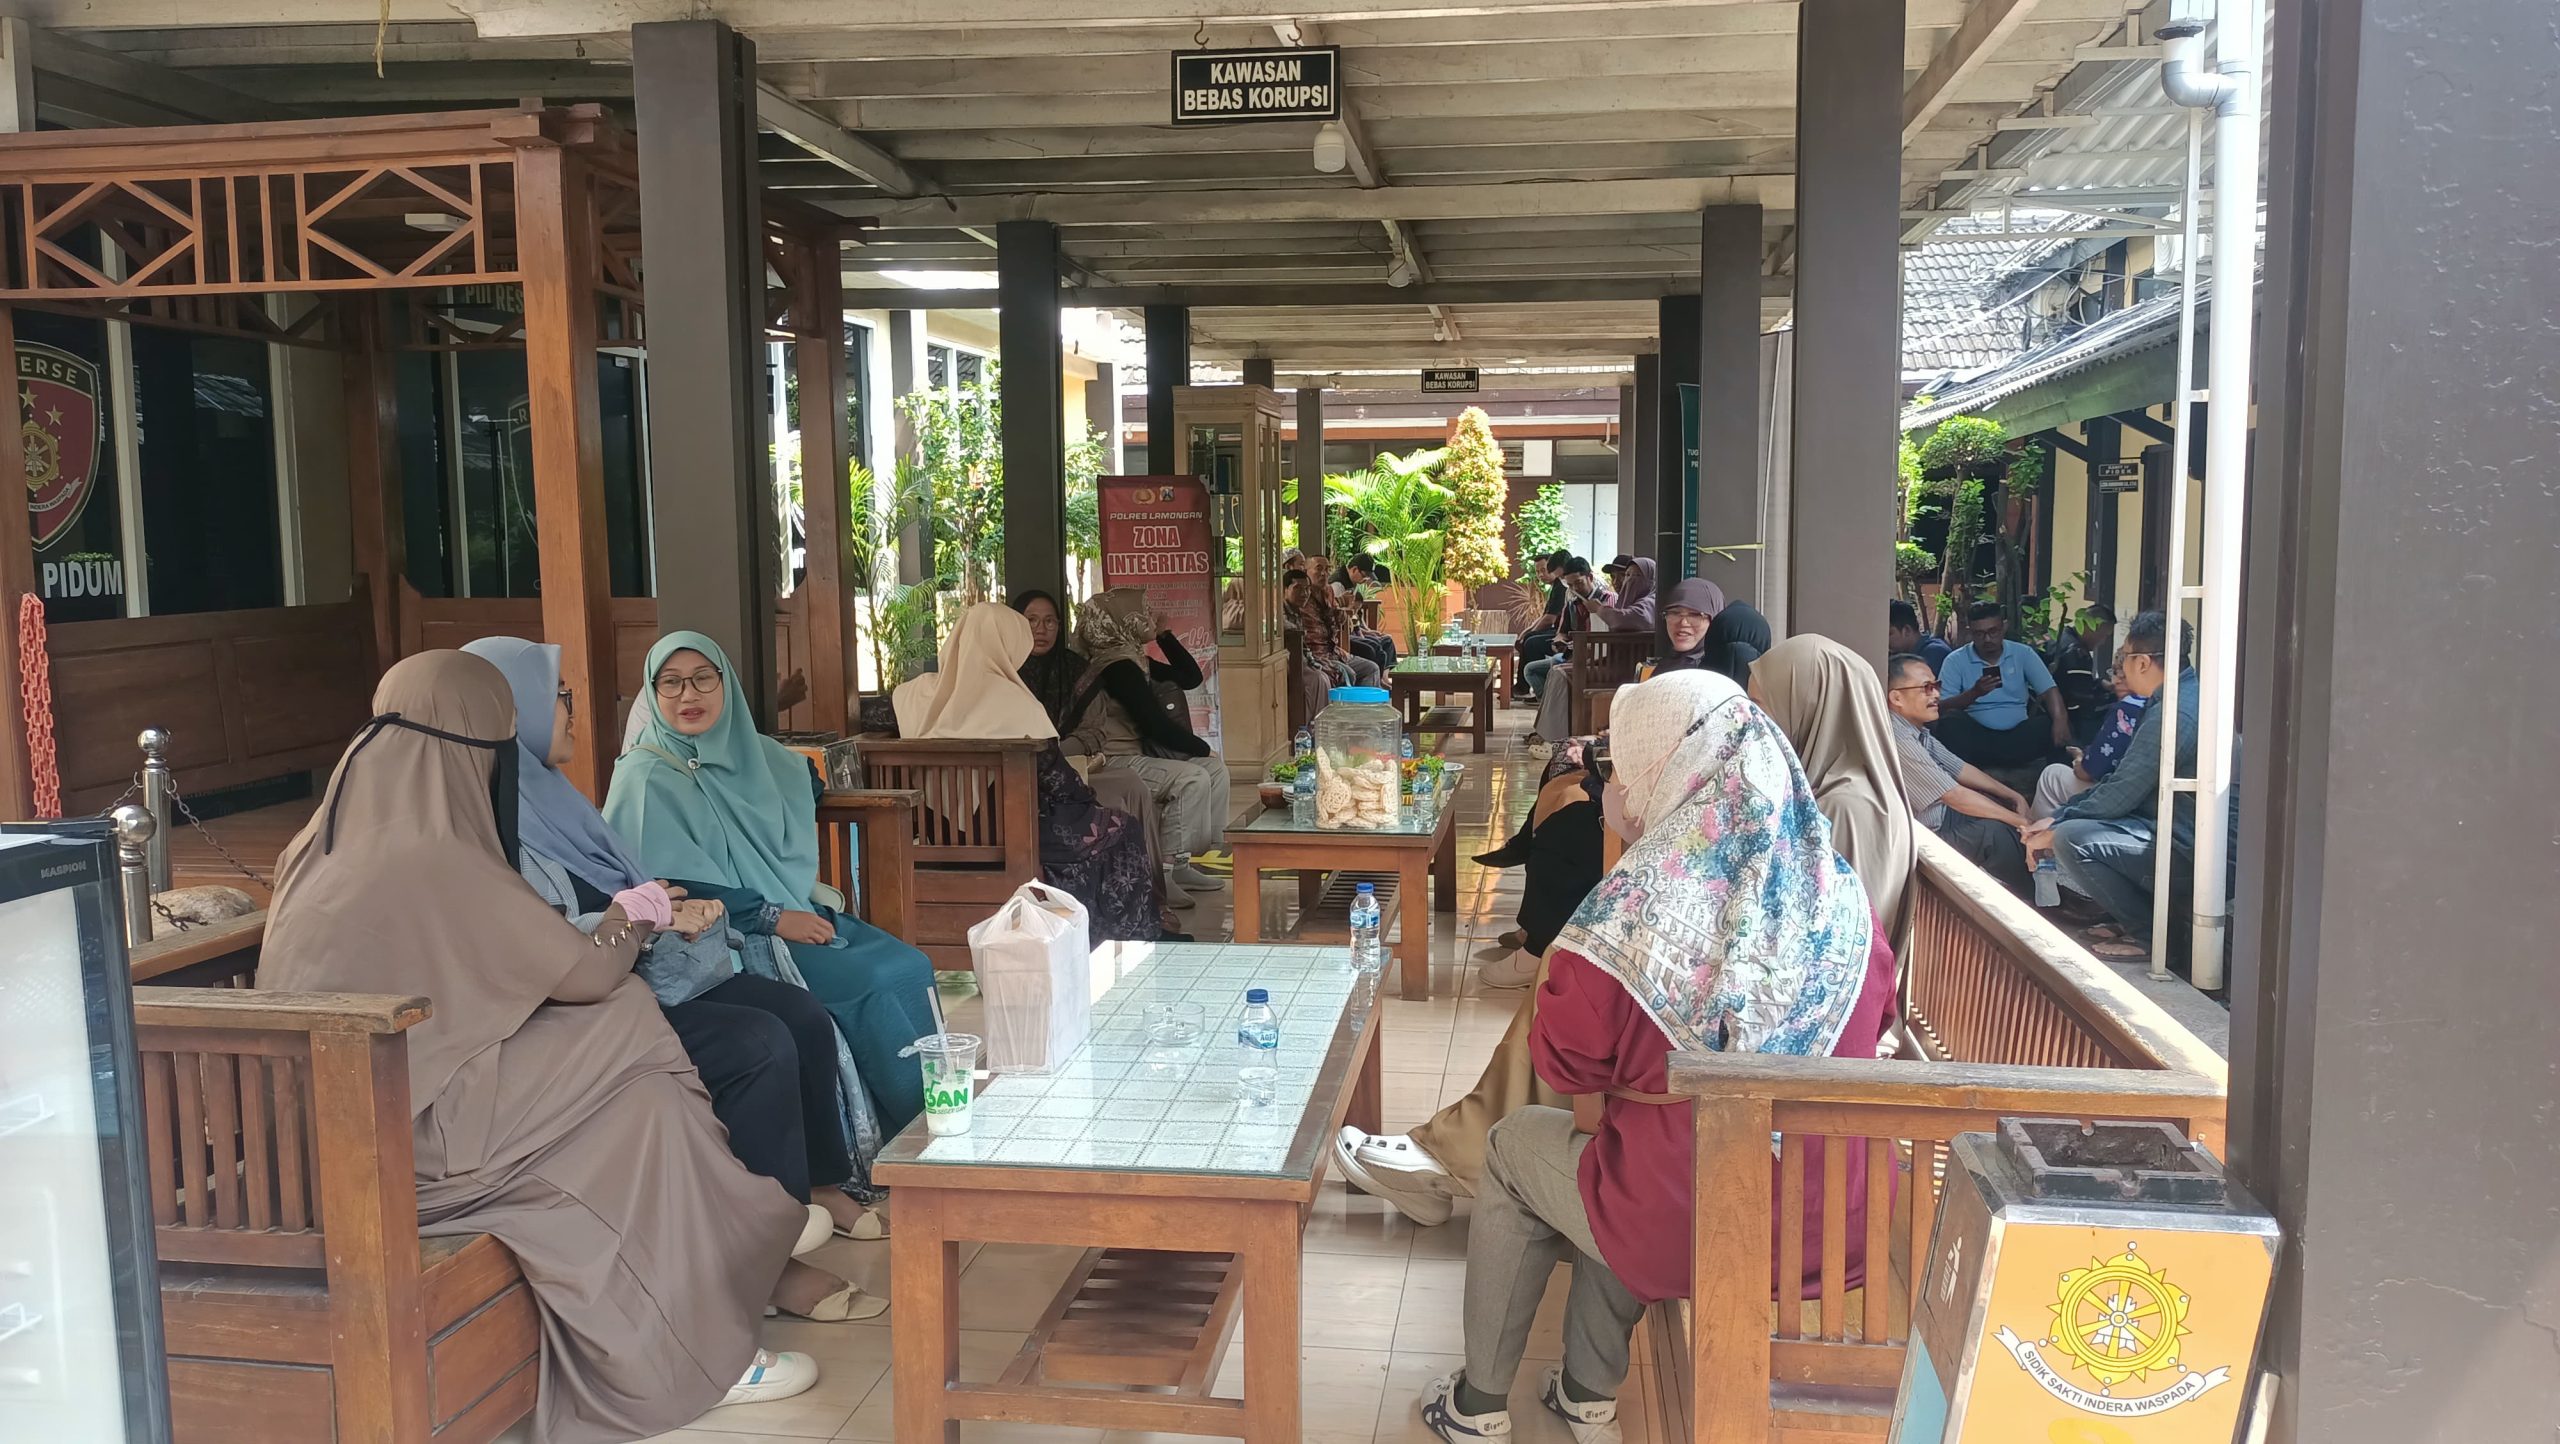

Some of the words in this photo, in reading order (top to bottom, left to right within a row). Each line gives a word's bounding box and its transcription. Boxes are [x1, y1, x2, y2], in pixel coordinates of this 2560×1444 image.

[1210, 60, 1301, 84] KAWASAN
[1184, 88, 1243, 111] BEBAS
[1249, 85, 1328, 109] KORUPSI
[20, 356, 77, 385] ERSE
[1434, 372, 1466, 380] KAWASAN
[1425, 381, 1446, 389] BEBAS
[1447, 380, 1475, 389] KORUPSI
[1110, 512, 1148, 520] POLRES
[1149, 511, 1203, 520] LAMONGAN
[1133, 526, 1181, 548] ZONA
[1107, 552, 1209, 575] INTEGRITAS
[42, 560, 123, 598] PIDUM
[40, 860, 87, 879] MASPION
[2024, 1350, 2049, 1380] SIDIK
[2047, 1377, 2083, 1403] SAKTI
[2084, 1393, 2133, 1413] INDERA
[2135, 1380, 2195, 1411] WASPADA
[1585, 1409, 1608, 1419] Tiger
[1483, 1419, 1505, 1432] Tiger
